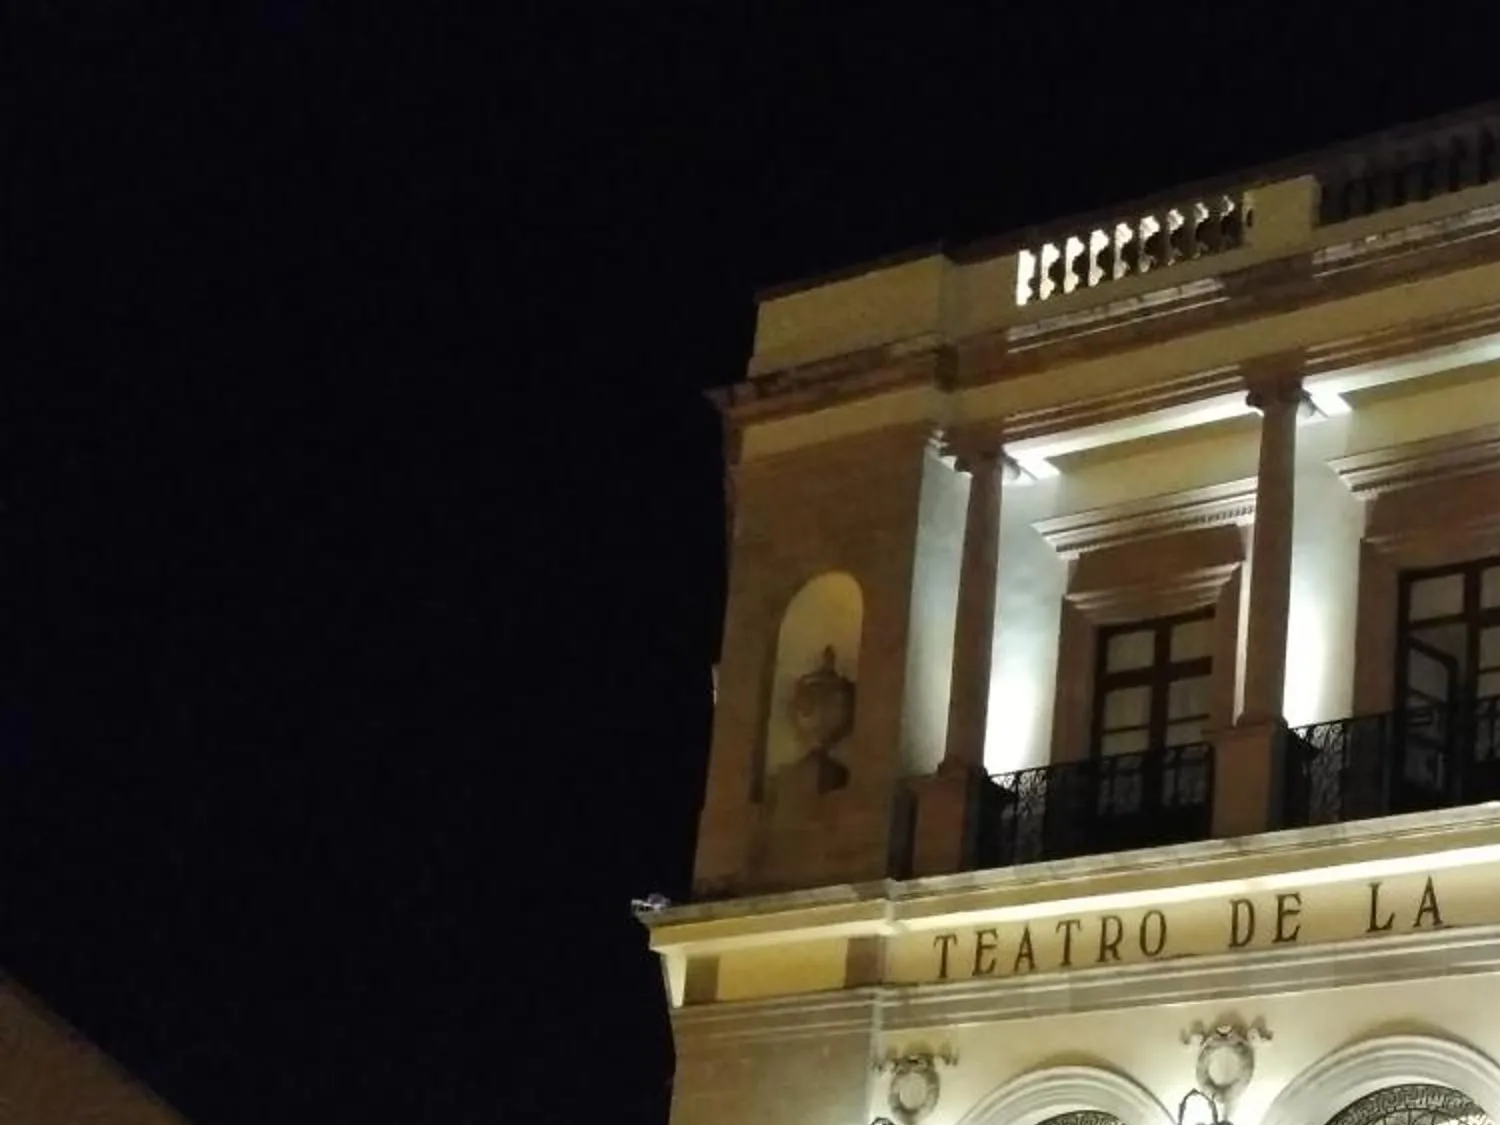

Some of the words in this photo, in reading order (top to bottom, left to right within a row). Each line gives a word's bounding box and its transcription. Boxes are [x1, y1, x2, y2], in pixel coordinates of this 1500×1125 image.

[934, 909, 1168, 980] TEATRO
[1228, 893, 1303, 949] DE
[1366, 875, 1445, 934] LA
